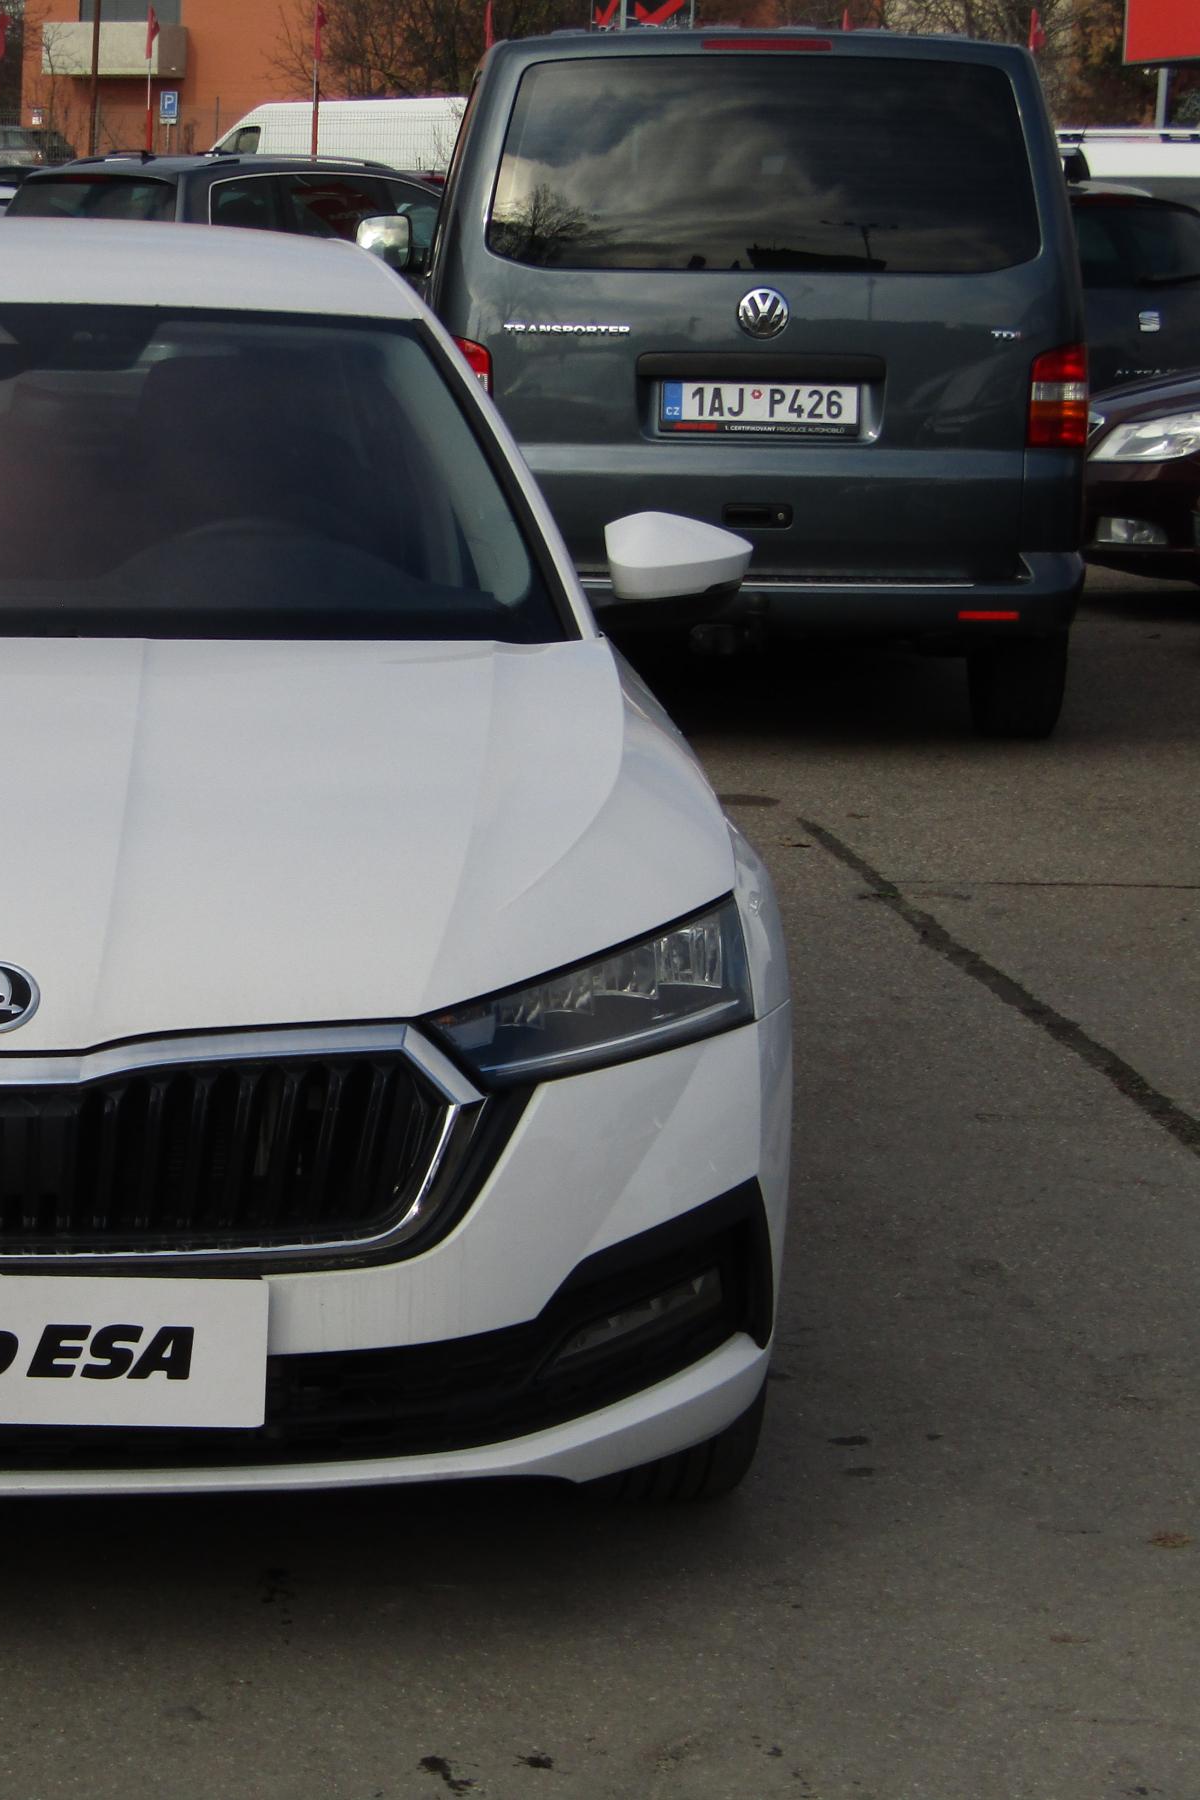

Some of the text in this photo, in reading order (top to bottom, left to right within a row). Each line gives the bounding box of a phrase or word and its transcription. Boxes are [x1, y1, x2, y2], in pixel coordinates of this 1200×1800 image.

[164, 95, 174, 110] P
[503, 323, 631, 336] TRANSPORTER
[691, 386, 843, 419] 1AJ P426
[665, 406, 680, 416] CZ
[26, 1324, 194, 1380] ESA
